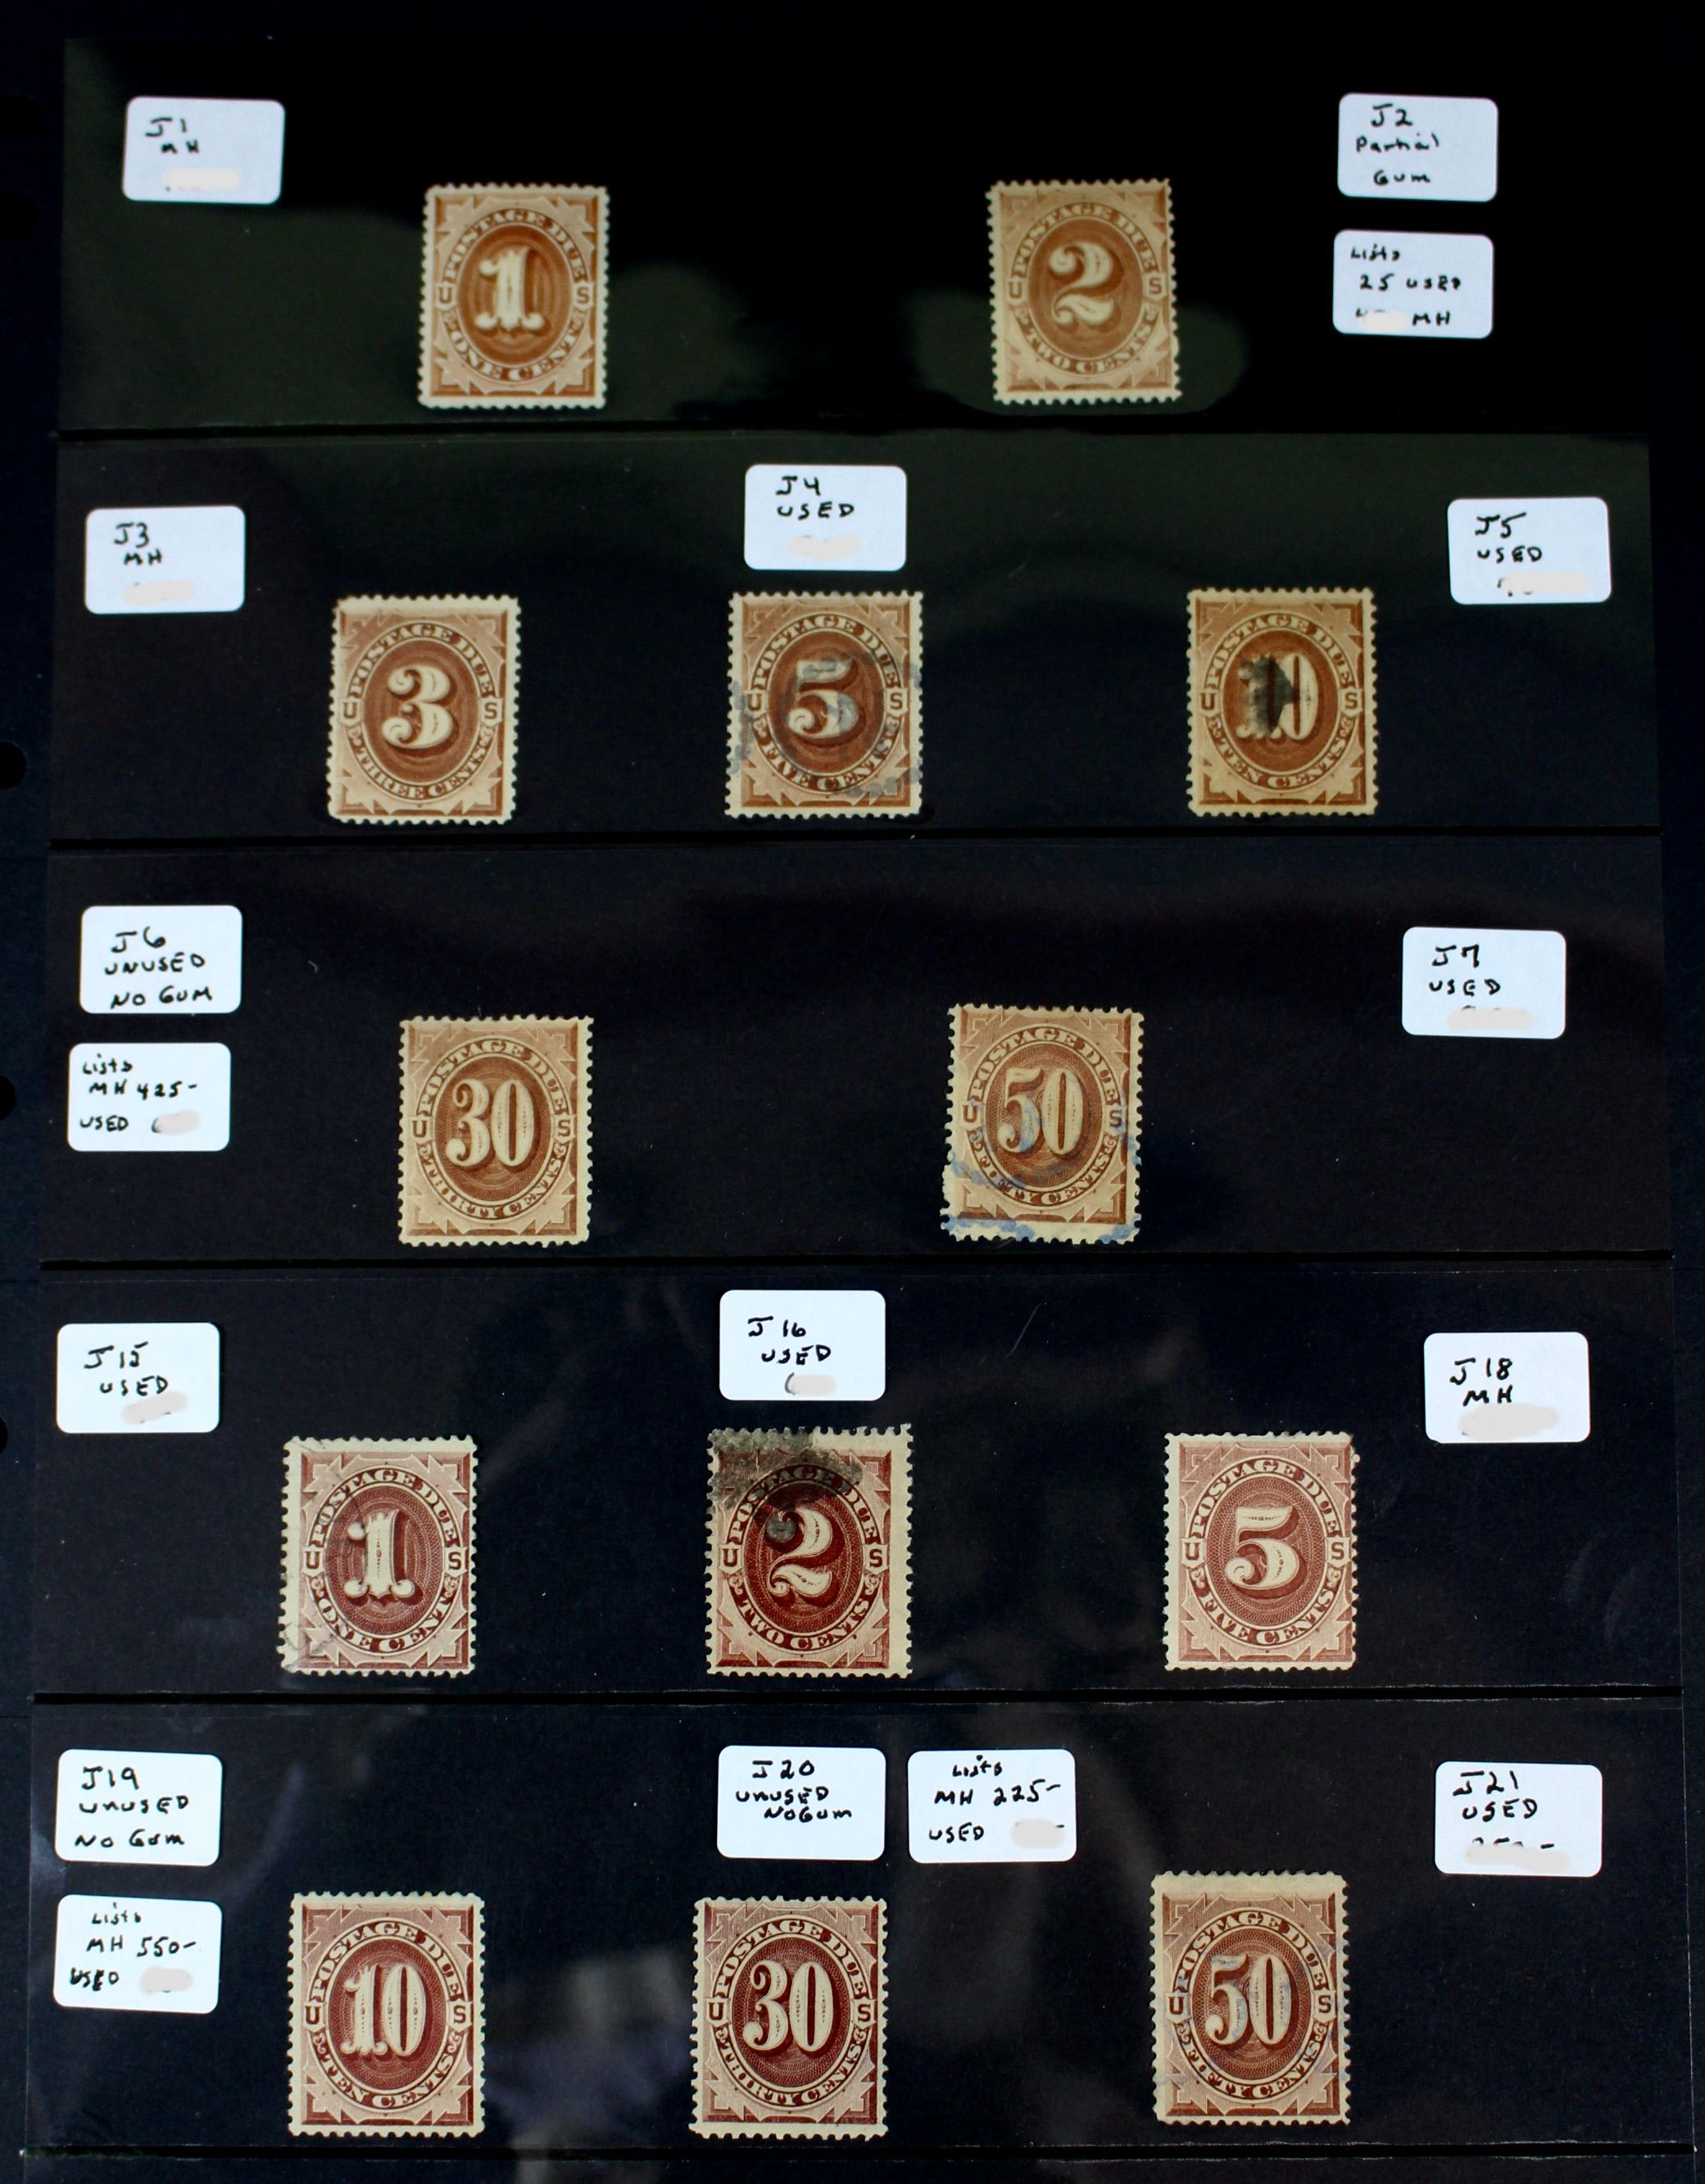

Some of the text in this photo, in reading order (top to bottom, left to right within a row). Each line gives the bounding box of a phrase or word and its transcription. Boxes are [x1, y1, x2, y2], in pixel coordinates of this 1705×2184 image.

[145, 116, 187, 138] J1
[1370, 102, 1413, 128] J2
[447, 210, 587, 282] POSTAGE DUE
[1015, 204, 1159, 277] POSTAGE DUE
[439, 288, 589, 302] U S
[476, 249, 544, 329] 1
[1009, 279, 1161, 297] U S
[1050, 242, 1114, 324] 2
[1359, 273, 1394, 292] 25
[1412, 310, 1451, 326] MH
[451, 326, 580, 381] ONE CENT
[1025, 324, 1152, 373] TWO CENTS
[775, 475, 821, 496] J4
[777, 501, 855, 521] USED
[1474, 511, 1527, 539] J5
[114, 522, 150, 549] J3
[124, 549, 162, 565] MH
[1476, 545, 1543, 564] USED
[350, 623, 496, 696] POSTAGE DUE
[754, 614, 900, 687] POSTAGE DUE
[1206, 614, 1355, 687] POSTAGE DUE
[343, 704, 497, 718] U S
[383, 664, 451, 748] 3
[748, 695, 902, 709] U S
[788, 659, 858, 738] 5
[1200, 692, 1358, 709] U S
[1236, 655, 1319, 740] 10
[358, 747, 489, 799] THREE CENTS
[765, 739, 893, 791] FIVE CENTS
[1219, 736, 1346, 787] TEN CENTS
[111, 927, 166, 954] J6
[104, 951, 206, 976] UNUSED
[1431, 944, 1480, 968] J7
[110, 992, 146, 1009] NO
[1428, 978, 1501, 997] USED
[419, 1040, 569, 1113] POSTAGE DUE
[969, 1027, 1119, 1103] POSTAGE DUE
[88, 1079, 127, 1095] MH
[79, 1114, 129, 1132] USED
[445, 1078, 534, 1167] 30
[964, 1105, 1121, 1127] U S
[1000, 1068, 1083, 1156] 50
[412, 1120, 570, 1137] U S
[424, 1159, 565, 1217] THIRTY CENTS
[977, 1155, 1109, 1205] FIFTY CENTS
[747, 1315, 807, 1338] J16
[84, 1341, 148, 1371] J15
[761, 1343, 832, 1366] USED
[1449, 1357, 1513, 1386] J18
[99, 1375, 169, 1397] USED
[1462, 1384, 1513, 1407] MH
[311, 1470, 458, 1545] POSTAGE DUE
[730, 1467, 878, 1541] POSTAGE DUE
[1192, 1461, 1341, 1535] POSTAGE DUE
[306, 1552, 461, 1570] U S
[344, 1510, 415, 1598] 1
[723, 1548, 882, 1567] U S
[766, 1507, 832, 1597] 2
[1186, 1542, 1344, 1559] U S
[1225, 1506, 1299, 1590] 5
[318, 1594, 453, 1652] ONE CENT
[740, 1599, 868, 1649] TWO CENTS
[1202, 1588, 1334, 1644] FIVE CENTS
[81, 1765, 139, 1791] J19
[752, 1759, 815, 1780] J20
[1452, 1770, 1519, 1797] J21
[934, 1788, 973, 1806] MH
[1462, 1797, 1538, 1823] USED
[928, 1821, 985, 1844] USED
[86, 1935, 123, 1953] MH
[714, 1919, 868, 1996] POSTAGE DUE
[1176, 1912, 1327, 1991] POSTAGE DUE
[311, 1923, 462, 2000] POSTAGE DUE
[70, 1967, 120, 1991] USED
[340, 1964, 426, 2056] 10
[709, 2002, 870, 2022] U S
[742, 1960, 832, 2050] 30
[1169, 1996, 1331, 2014] U S
[1205, 1954, 1291, 2045] 50
[306, 2005, 465, 2024] U S
[323, 2055, 455, 2107] TEN CENTS
[723, 2042, 862, 2105] THIRTY CENTS
[1187, 2044, 1318, 2096] FIFTY CENTS
